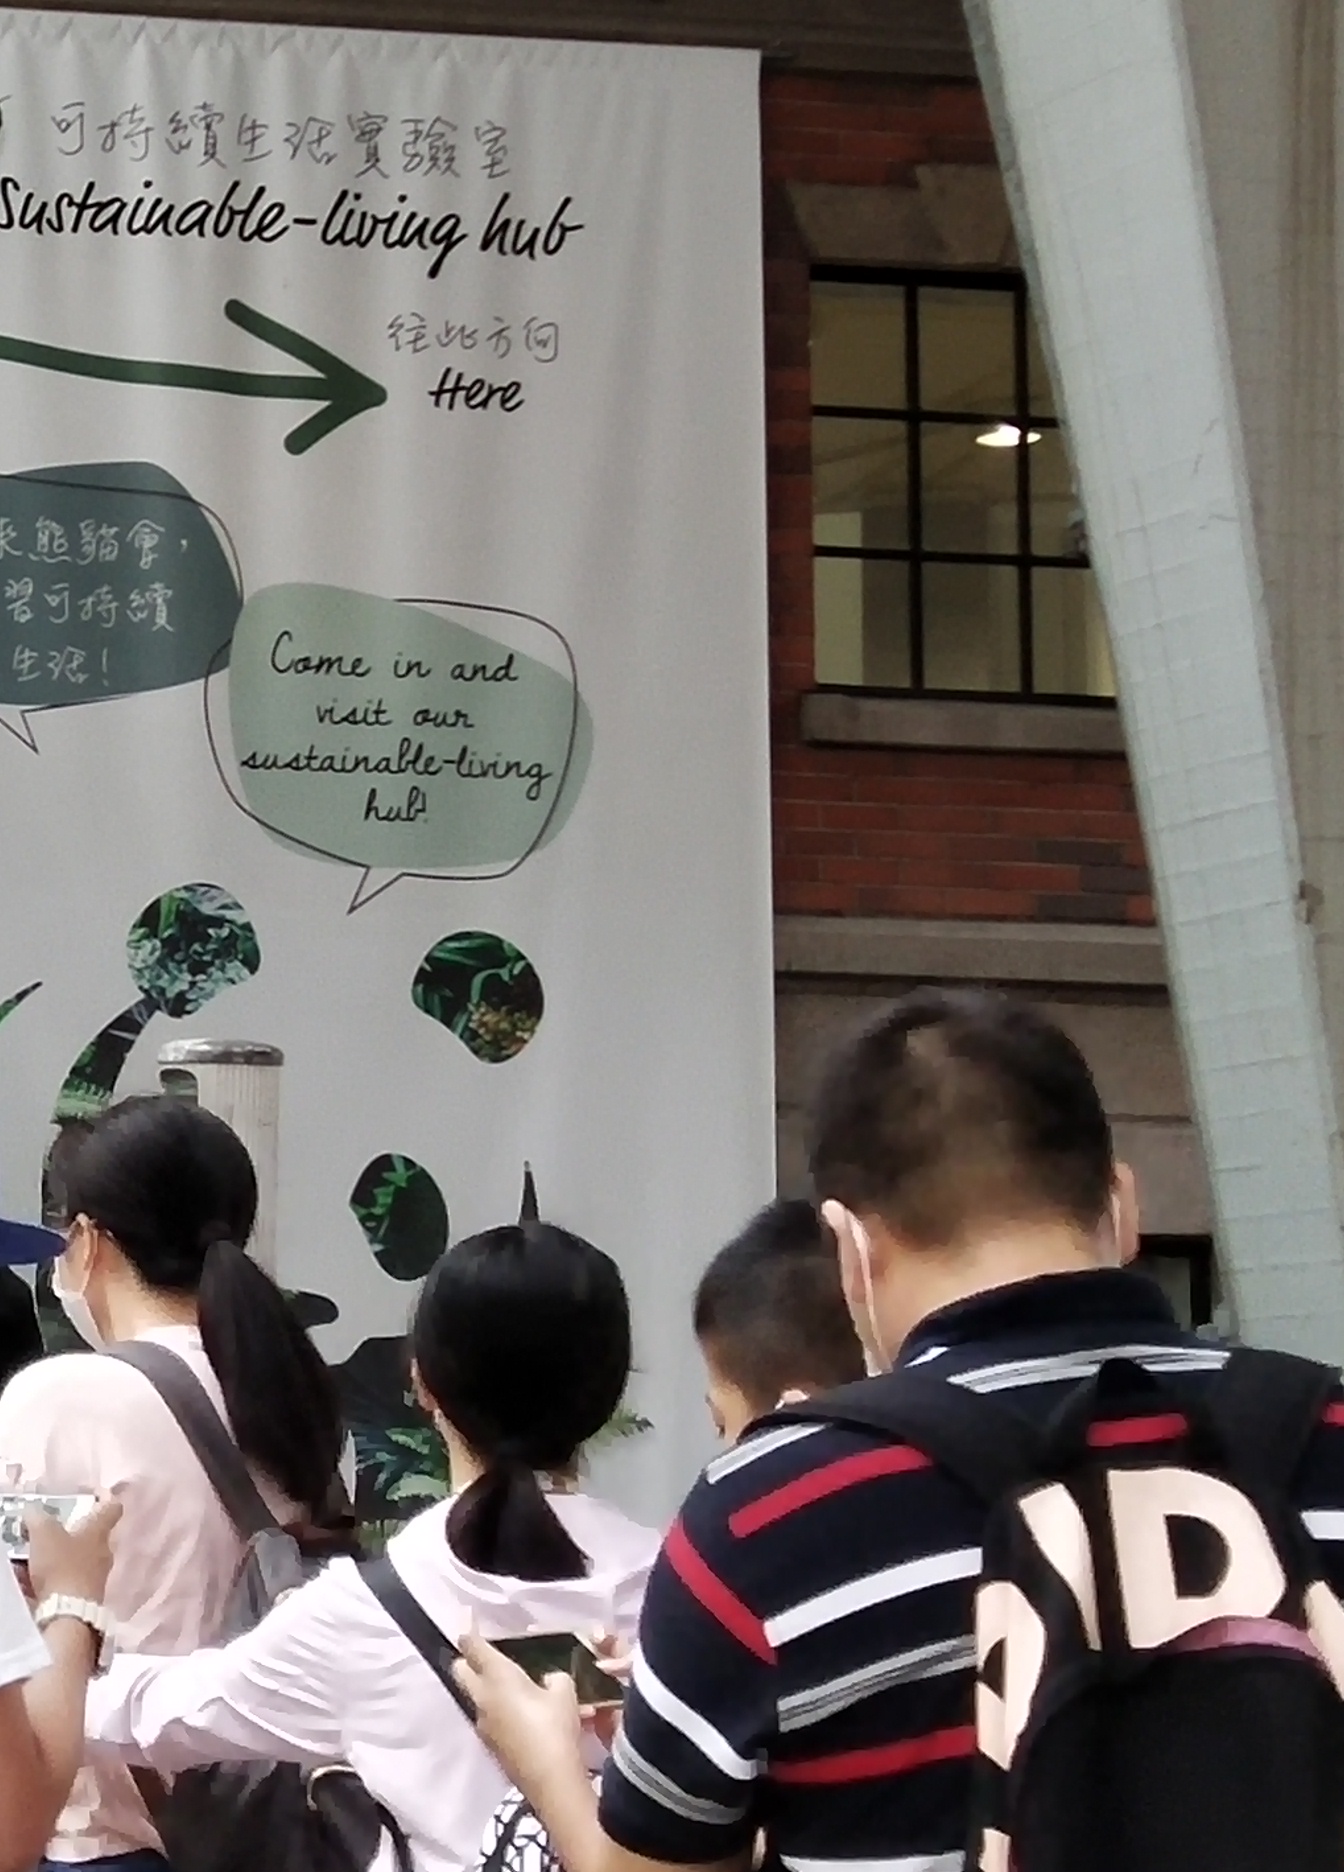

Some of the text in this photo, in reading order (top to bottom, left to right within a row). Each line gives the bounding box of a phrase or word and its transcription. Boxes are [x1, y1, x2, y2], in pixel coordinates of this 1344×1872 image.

[51, 102, 510, 180] 可持續生活實驗室
[480, 193, 585, 260] hub
[387, 314, 559, 364] 往此方向
[428, 367, 525, 412] Here
[270, 630, 519, 682] Come in and
[316, 698, 474, 728] visit our
[240, 737, 552, 801] sustainable-living
[363, 785, 428, 824] hub!
